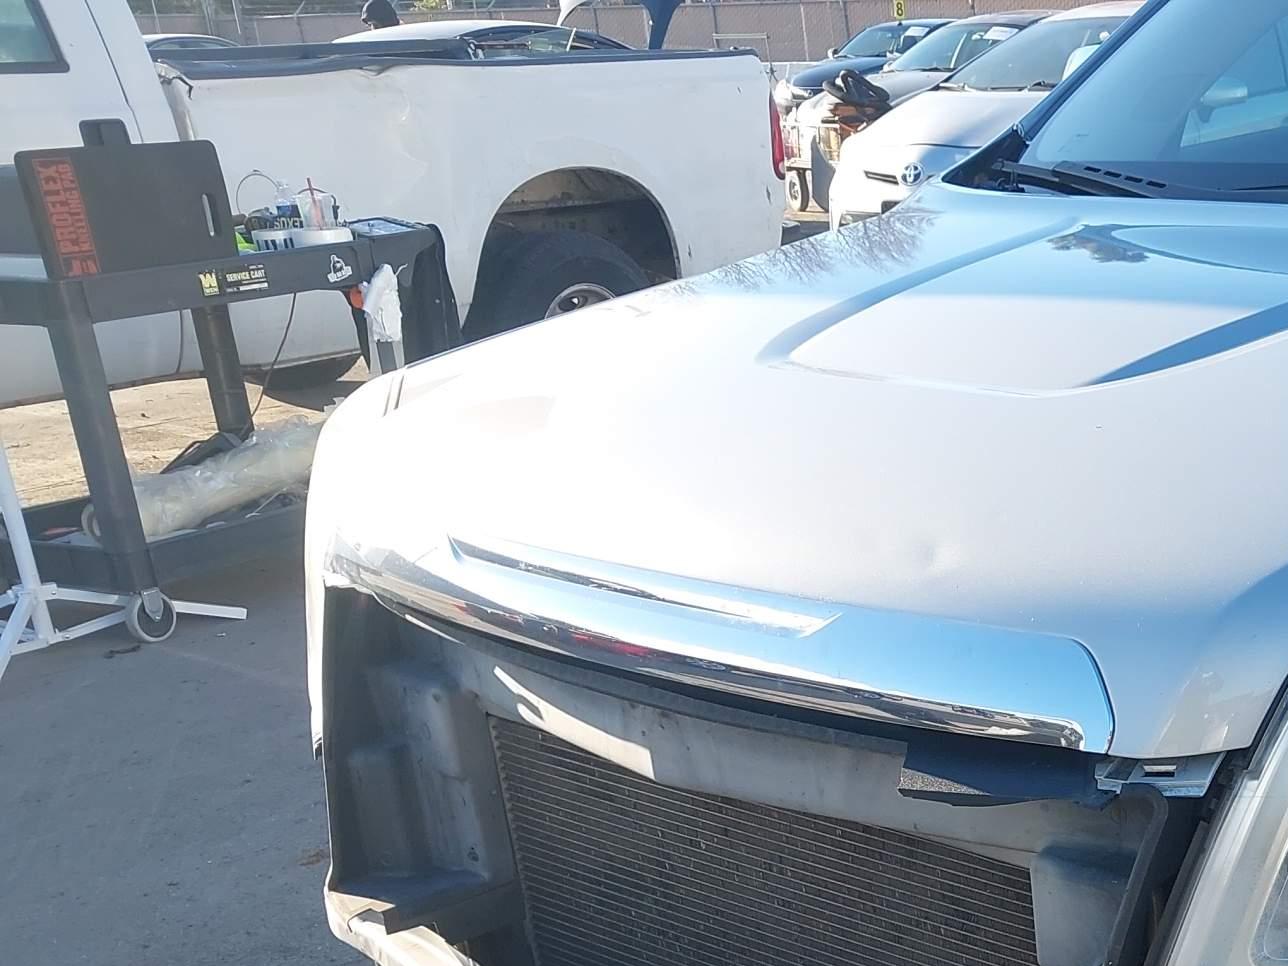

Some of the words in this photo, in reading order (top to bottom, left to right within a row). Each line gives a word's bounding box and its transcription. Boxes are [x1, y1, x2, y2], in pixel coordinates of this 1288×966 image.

[896, 2, 904, 17] 8
[58, 162, 77, 189] PAD
[37, 163, 80, 254] PROFLEX
[66, 189, 93, 252] KNEELING
[226, 271, 250, 282] SERVICE
[250, 269, 266, 279] CART
